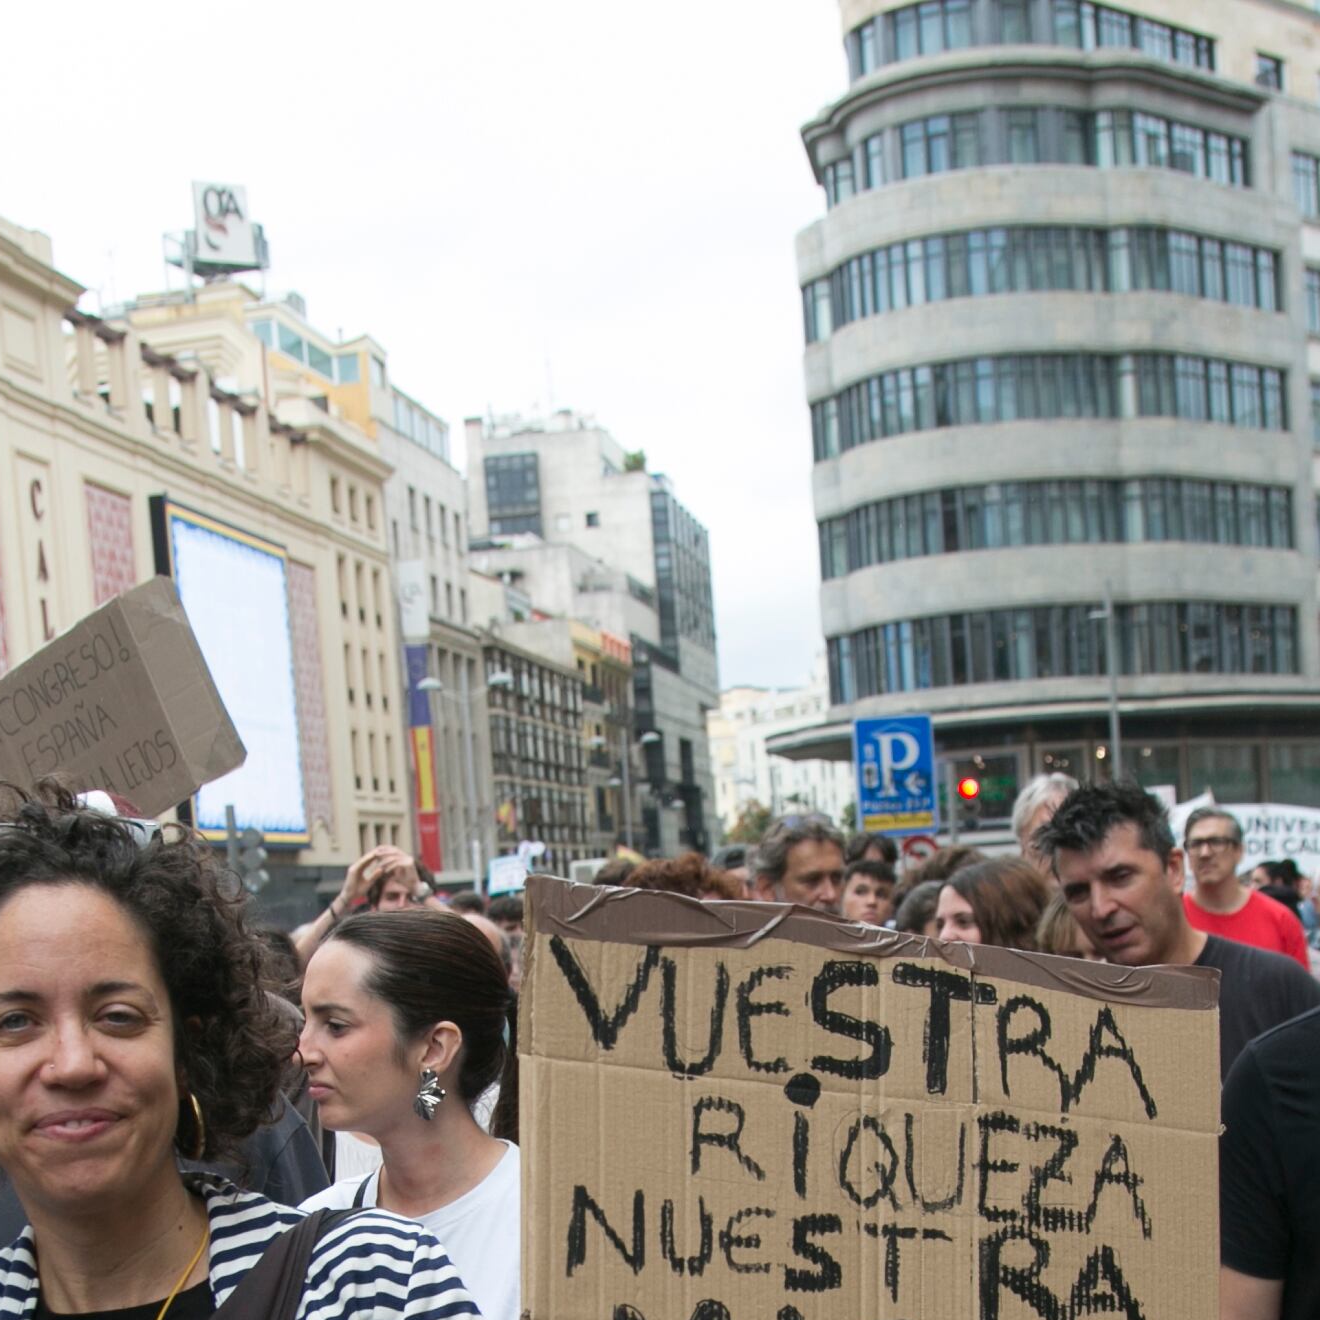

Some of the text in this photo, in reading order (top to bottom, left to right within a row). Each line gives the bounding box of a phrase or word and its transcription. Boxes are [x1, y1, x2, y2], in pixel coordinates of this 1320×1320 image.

[21, 701, 118, 779] ESPAÑA
[116, 729, 178, 791] LEJOS
[871, 731, 920, 798] P
[1247, 837, 1271, 855] DE
[548, 933, 1159, 1121] VUESTRA
